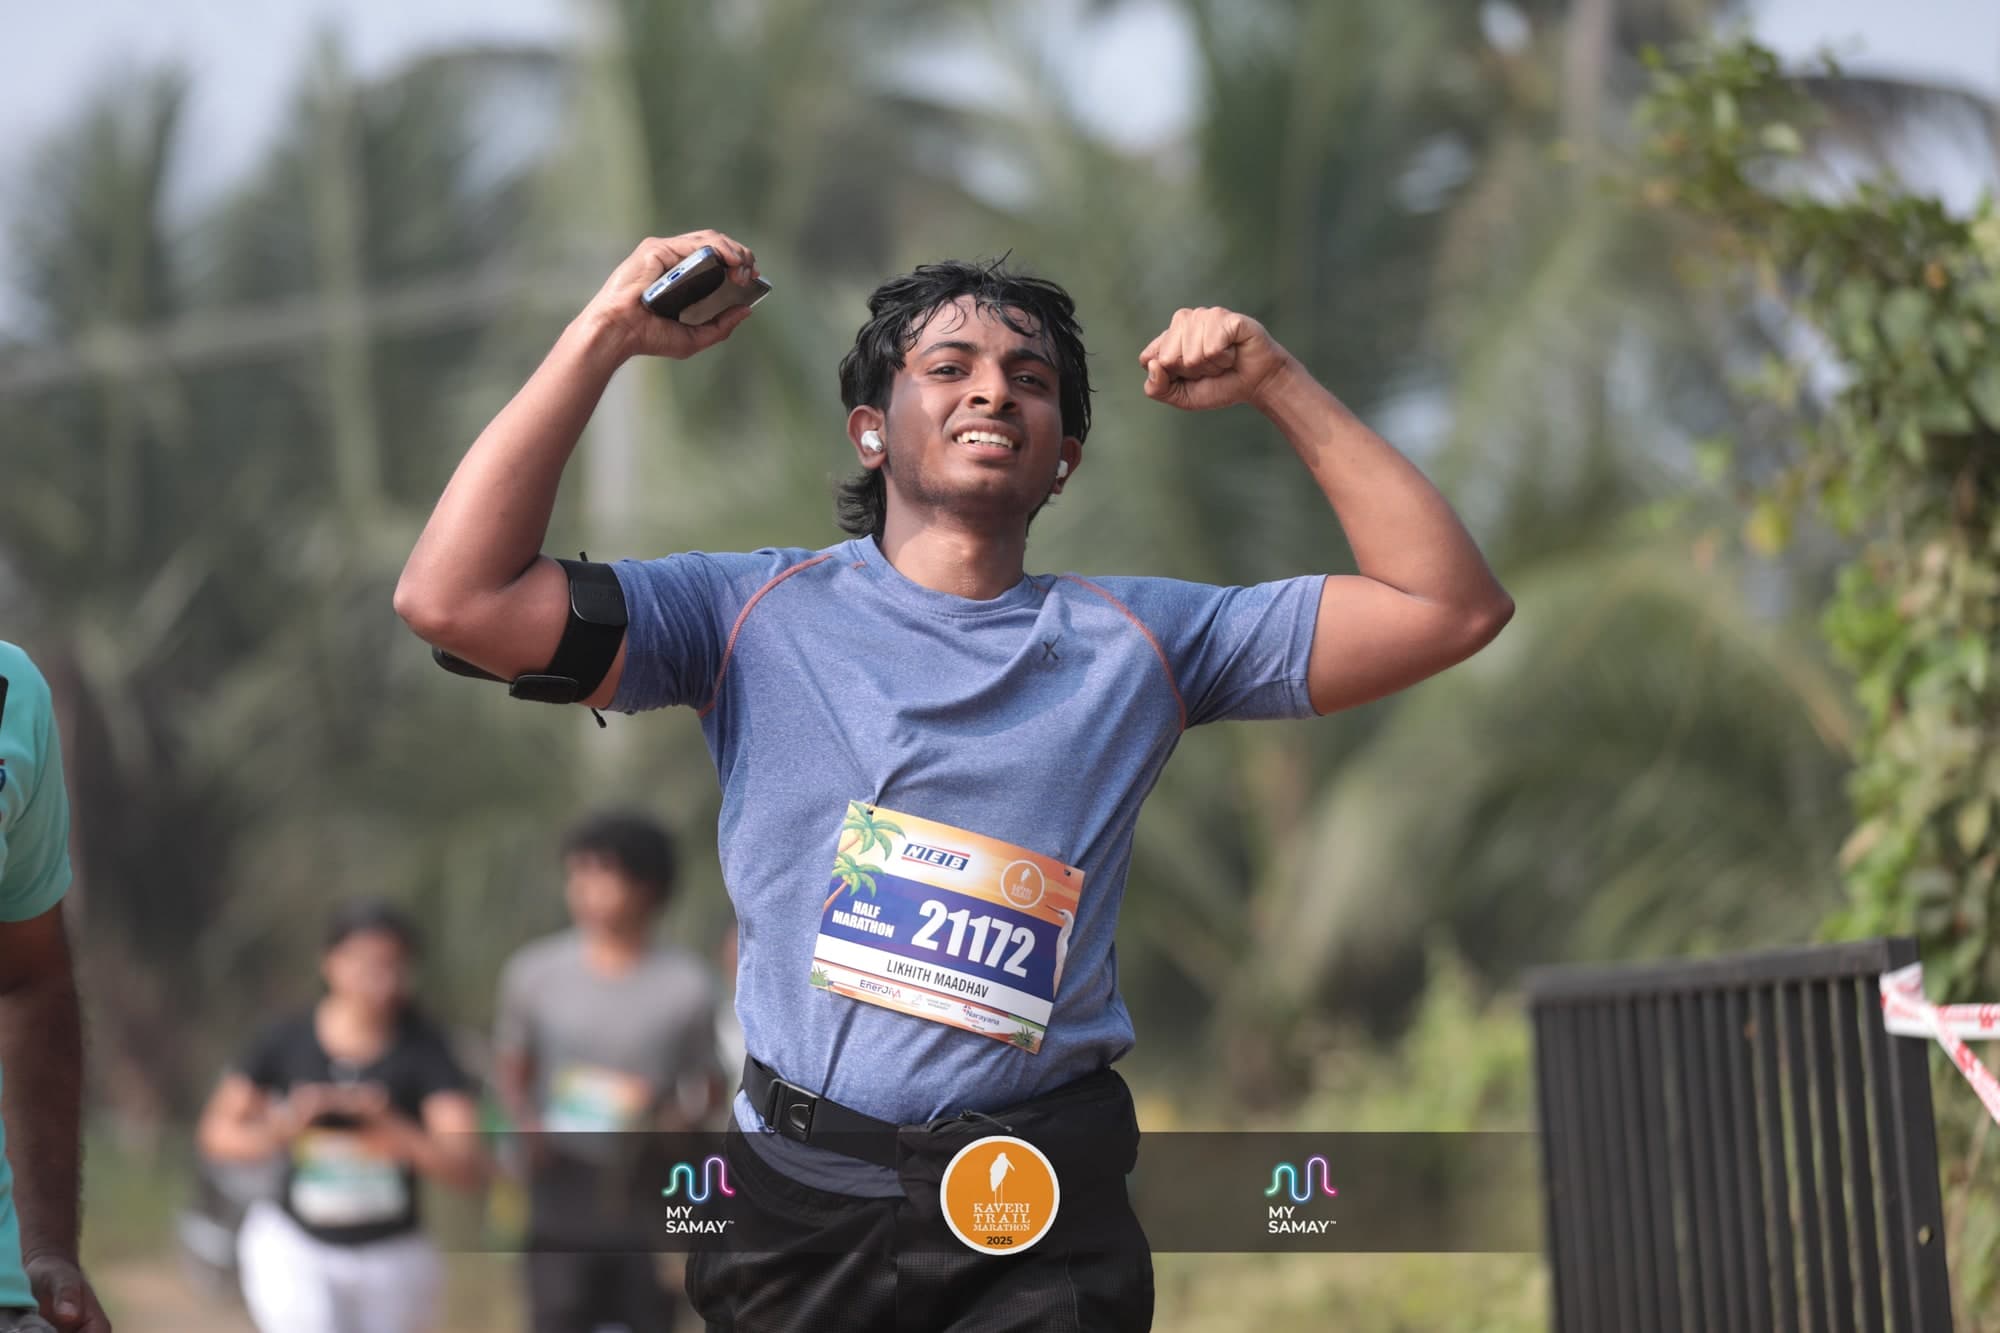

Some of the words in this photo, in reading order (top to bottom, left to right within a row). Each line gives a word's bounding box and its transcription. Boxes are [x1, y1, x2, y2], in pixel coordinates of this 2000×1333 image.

[905, 844, 967, 870] NEB
[852, 900, 881, 917] HALF
[832, 910, 895, 938] MARATHON
[911, 899, 1035, 978] 21172
[886, 959, 931, 982] LIKHITH
[934, 971, 989, 998] MAADHAV
